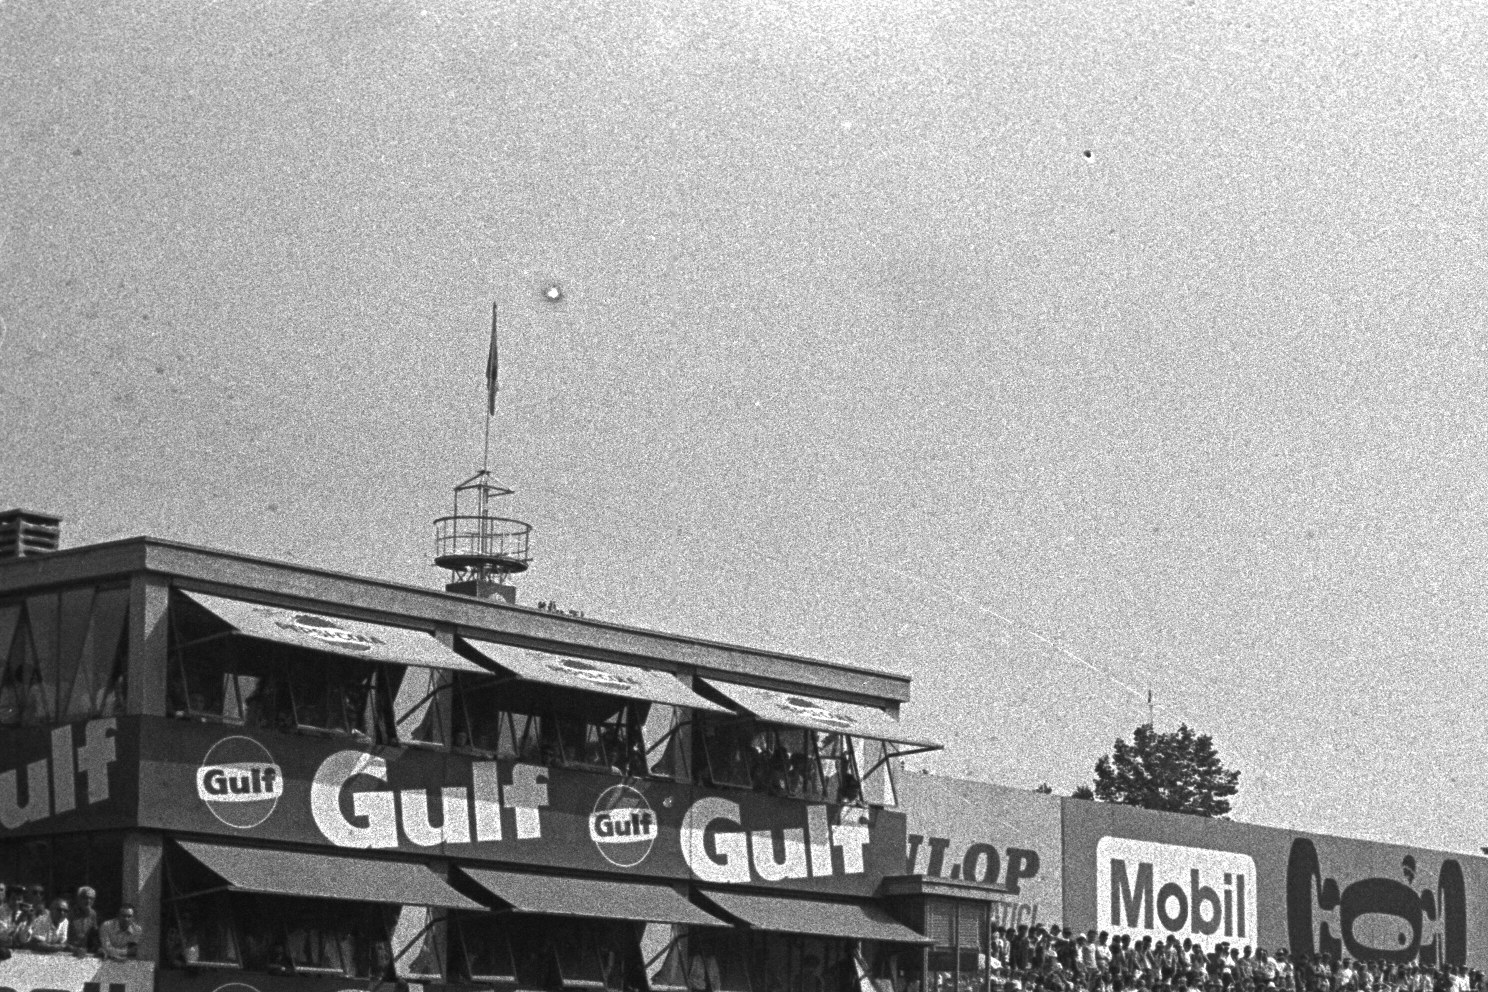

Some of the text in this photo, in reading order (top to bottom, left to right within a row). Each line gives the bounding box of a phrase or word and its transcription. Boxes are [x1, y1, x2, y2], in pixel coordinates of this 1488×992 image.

[203, 768, 277, 796] Gulf
[311, 750, 549, 849] Gulf
[594, 809, 653, 838] Gulf
[680, 797, 870, 883] Gulf
[1110, 858, 1246, 939] Mobil
